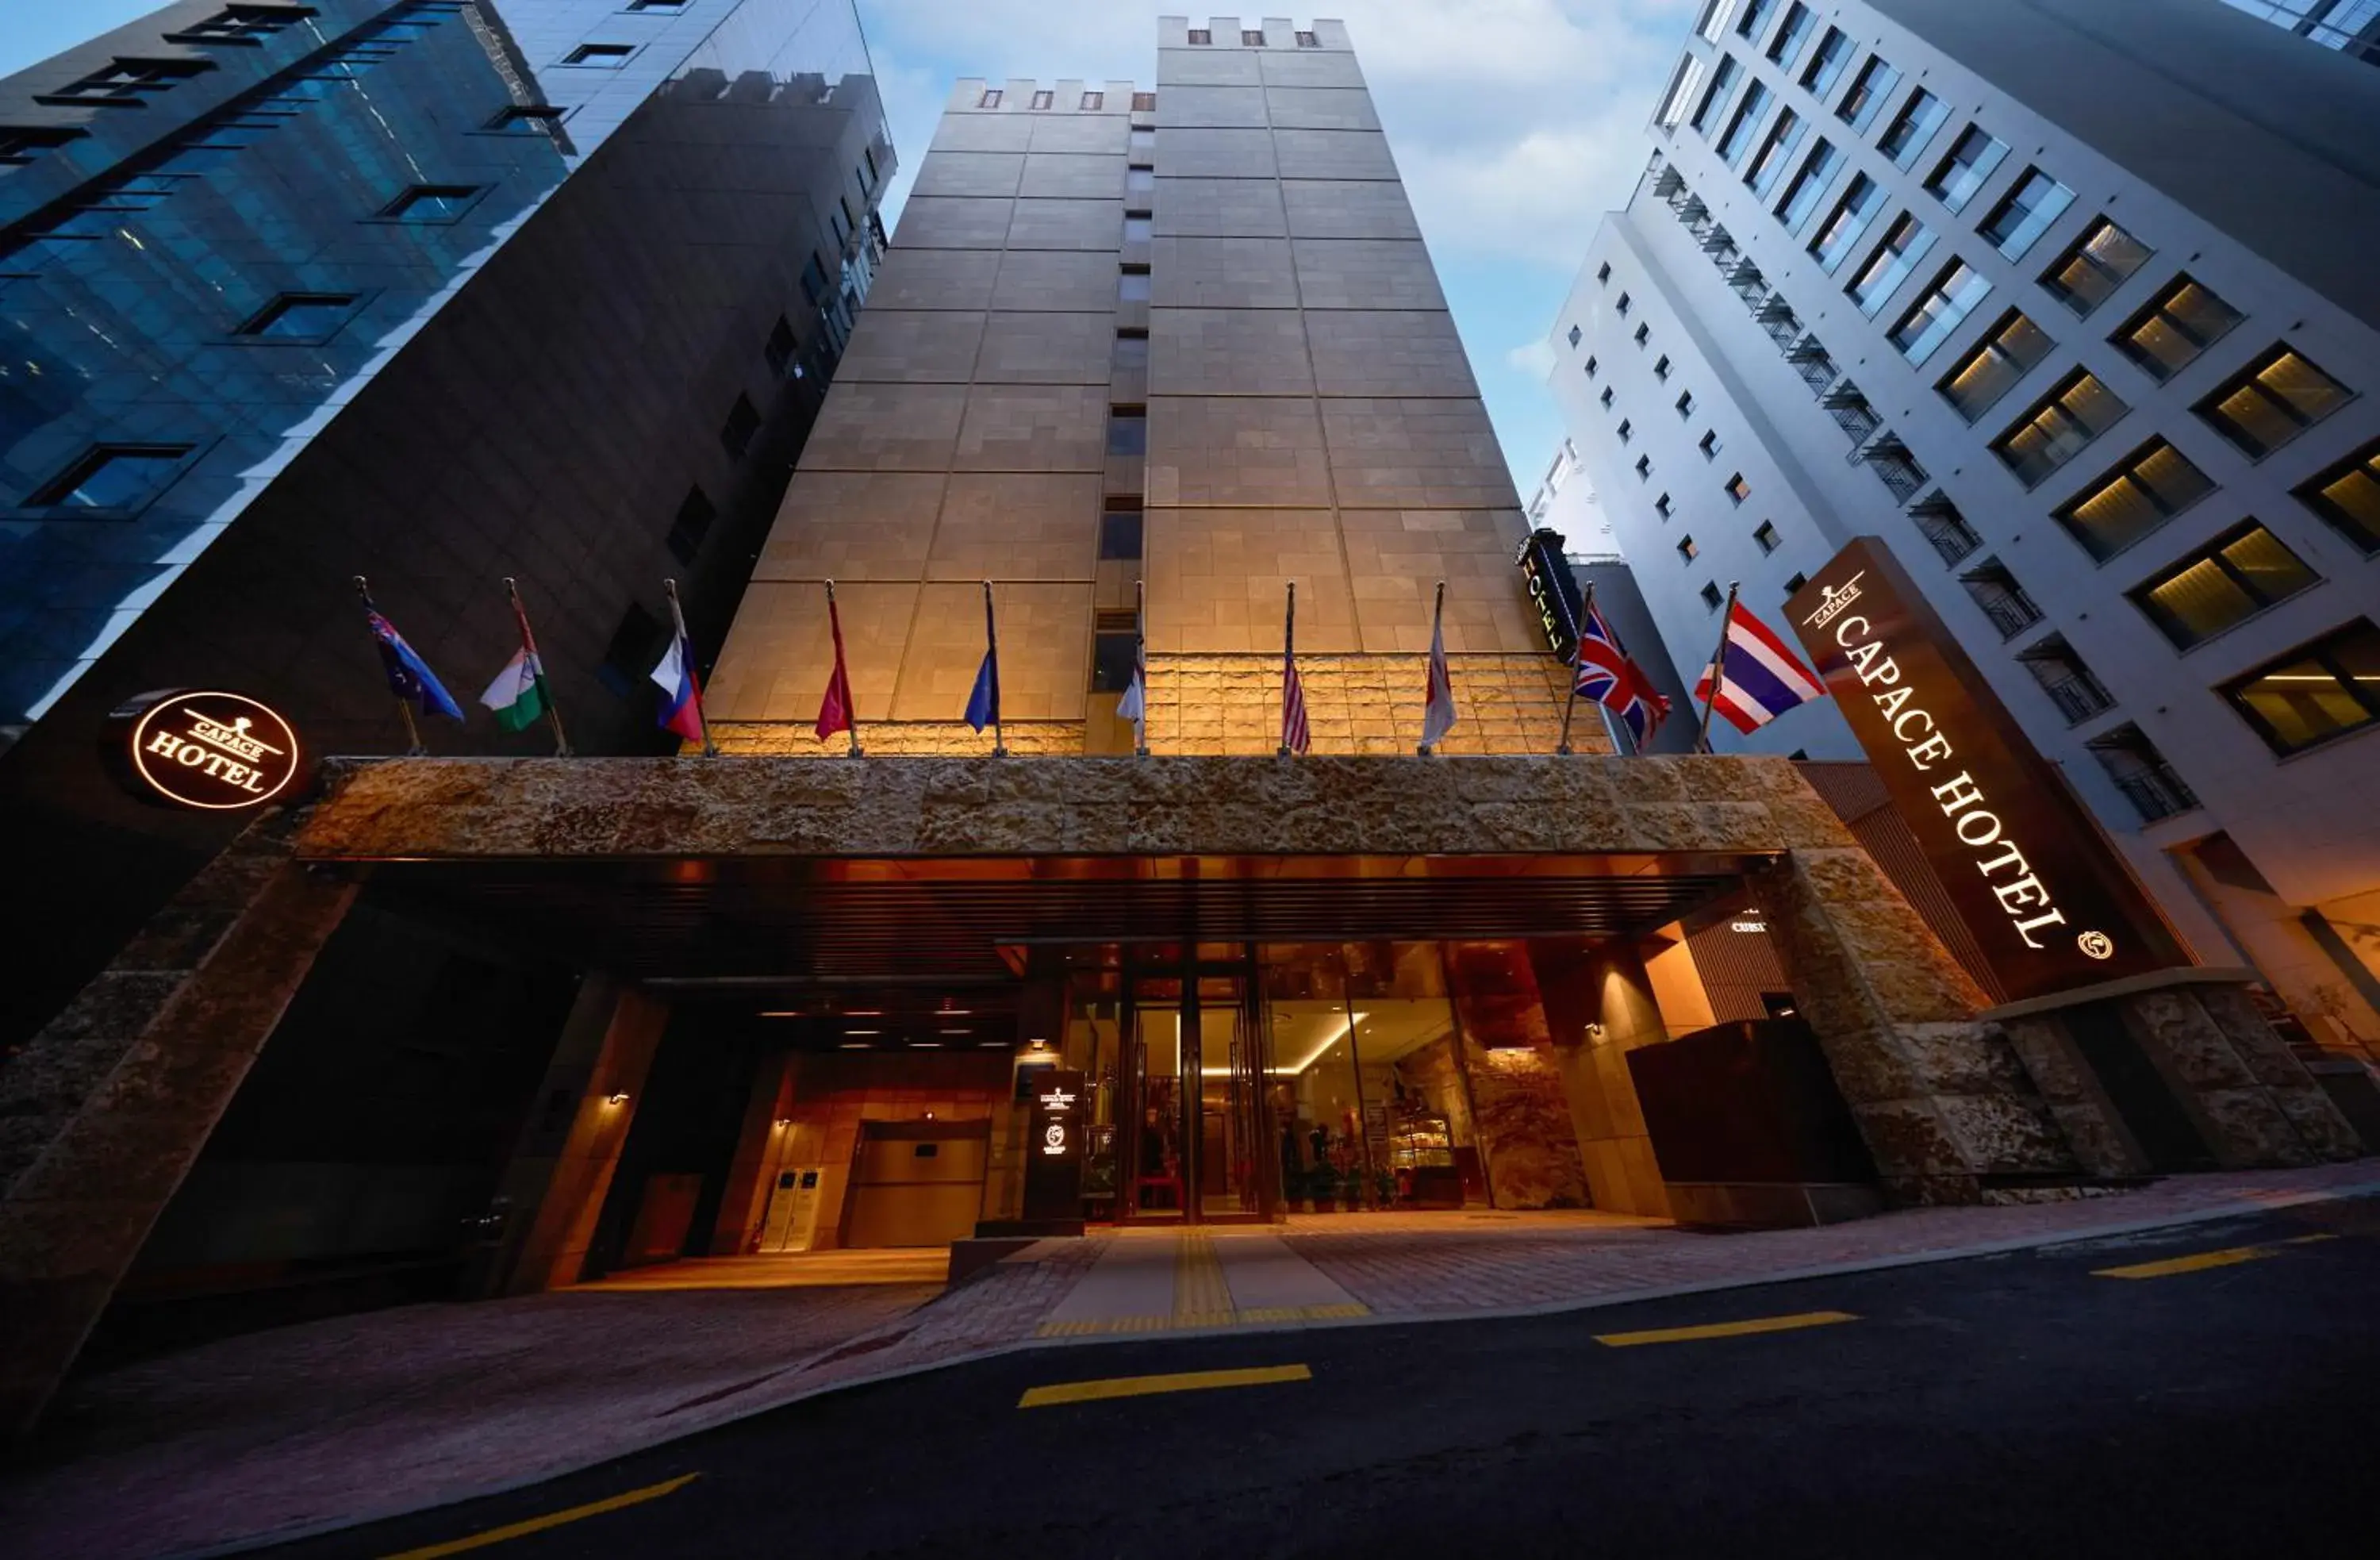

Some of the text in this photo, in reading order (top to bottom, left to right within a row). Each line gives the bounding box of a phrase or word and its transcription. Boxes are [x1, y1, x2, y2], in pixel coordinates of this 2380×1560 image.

[1522, 555, 1562, 652] HOTEL
[1814, 584, 1859, 624] CAPACE
[146, 730, 264, 793] HOTEL
[194, 721, 264, 758] CAPACE
[1836, 616, 2067, 949] CAPACE HOTEL
